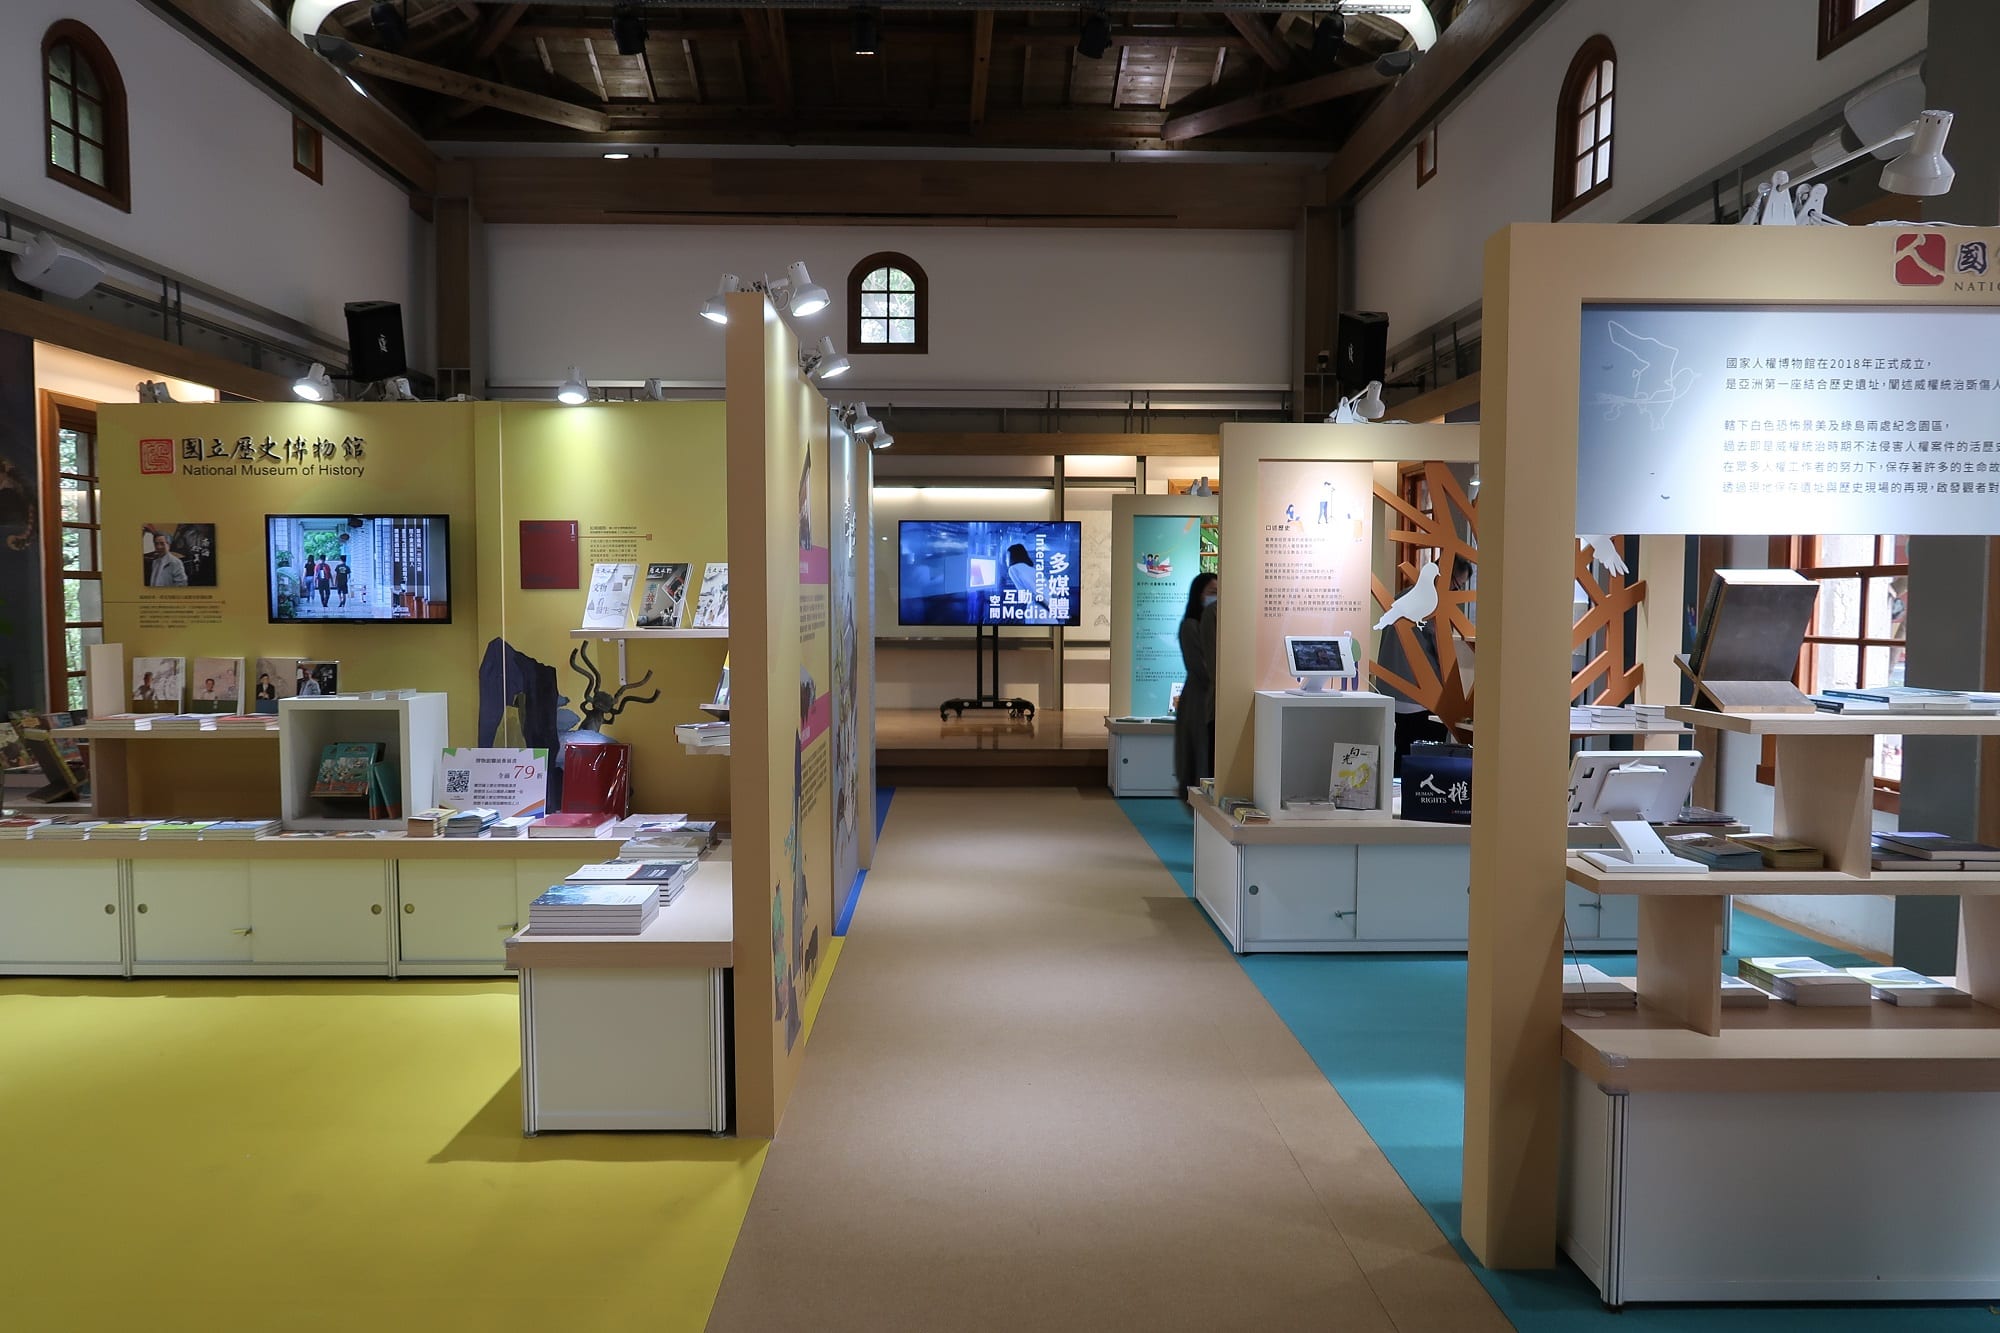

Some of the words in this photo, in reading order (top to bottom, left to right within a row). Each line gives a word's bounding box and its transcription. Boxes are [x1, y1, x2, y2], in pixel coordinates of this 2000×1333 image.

[1956, 241, 2000, 275] 國
[181, 435, 366, 463] 國立歷史博物館
[183, 465, 237, 476] National
[241, 465, 298, 476] Museum
[302, 464, 314, 476] of
[319, 464, 365, 478] History
[1035, 534, 1047, 602] Interactive
[1003, 589, 1032, 604] 互動
[1049, 552, 1070, 619] 多媒體
[989, 595, 1001, 619] 空間
[1002, 606, 1048, 619] Media
